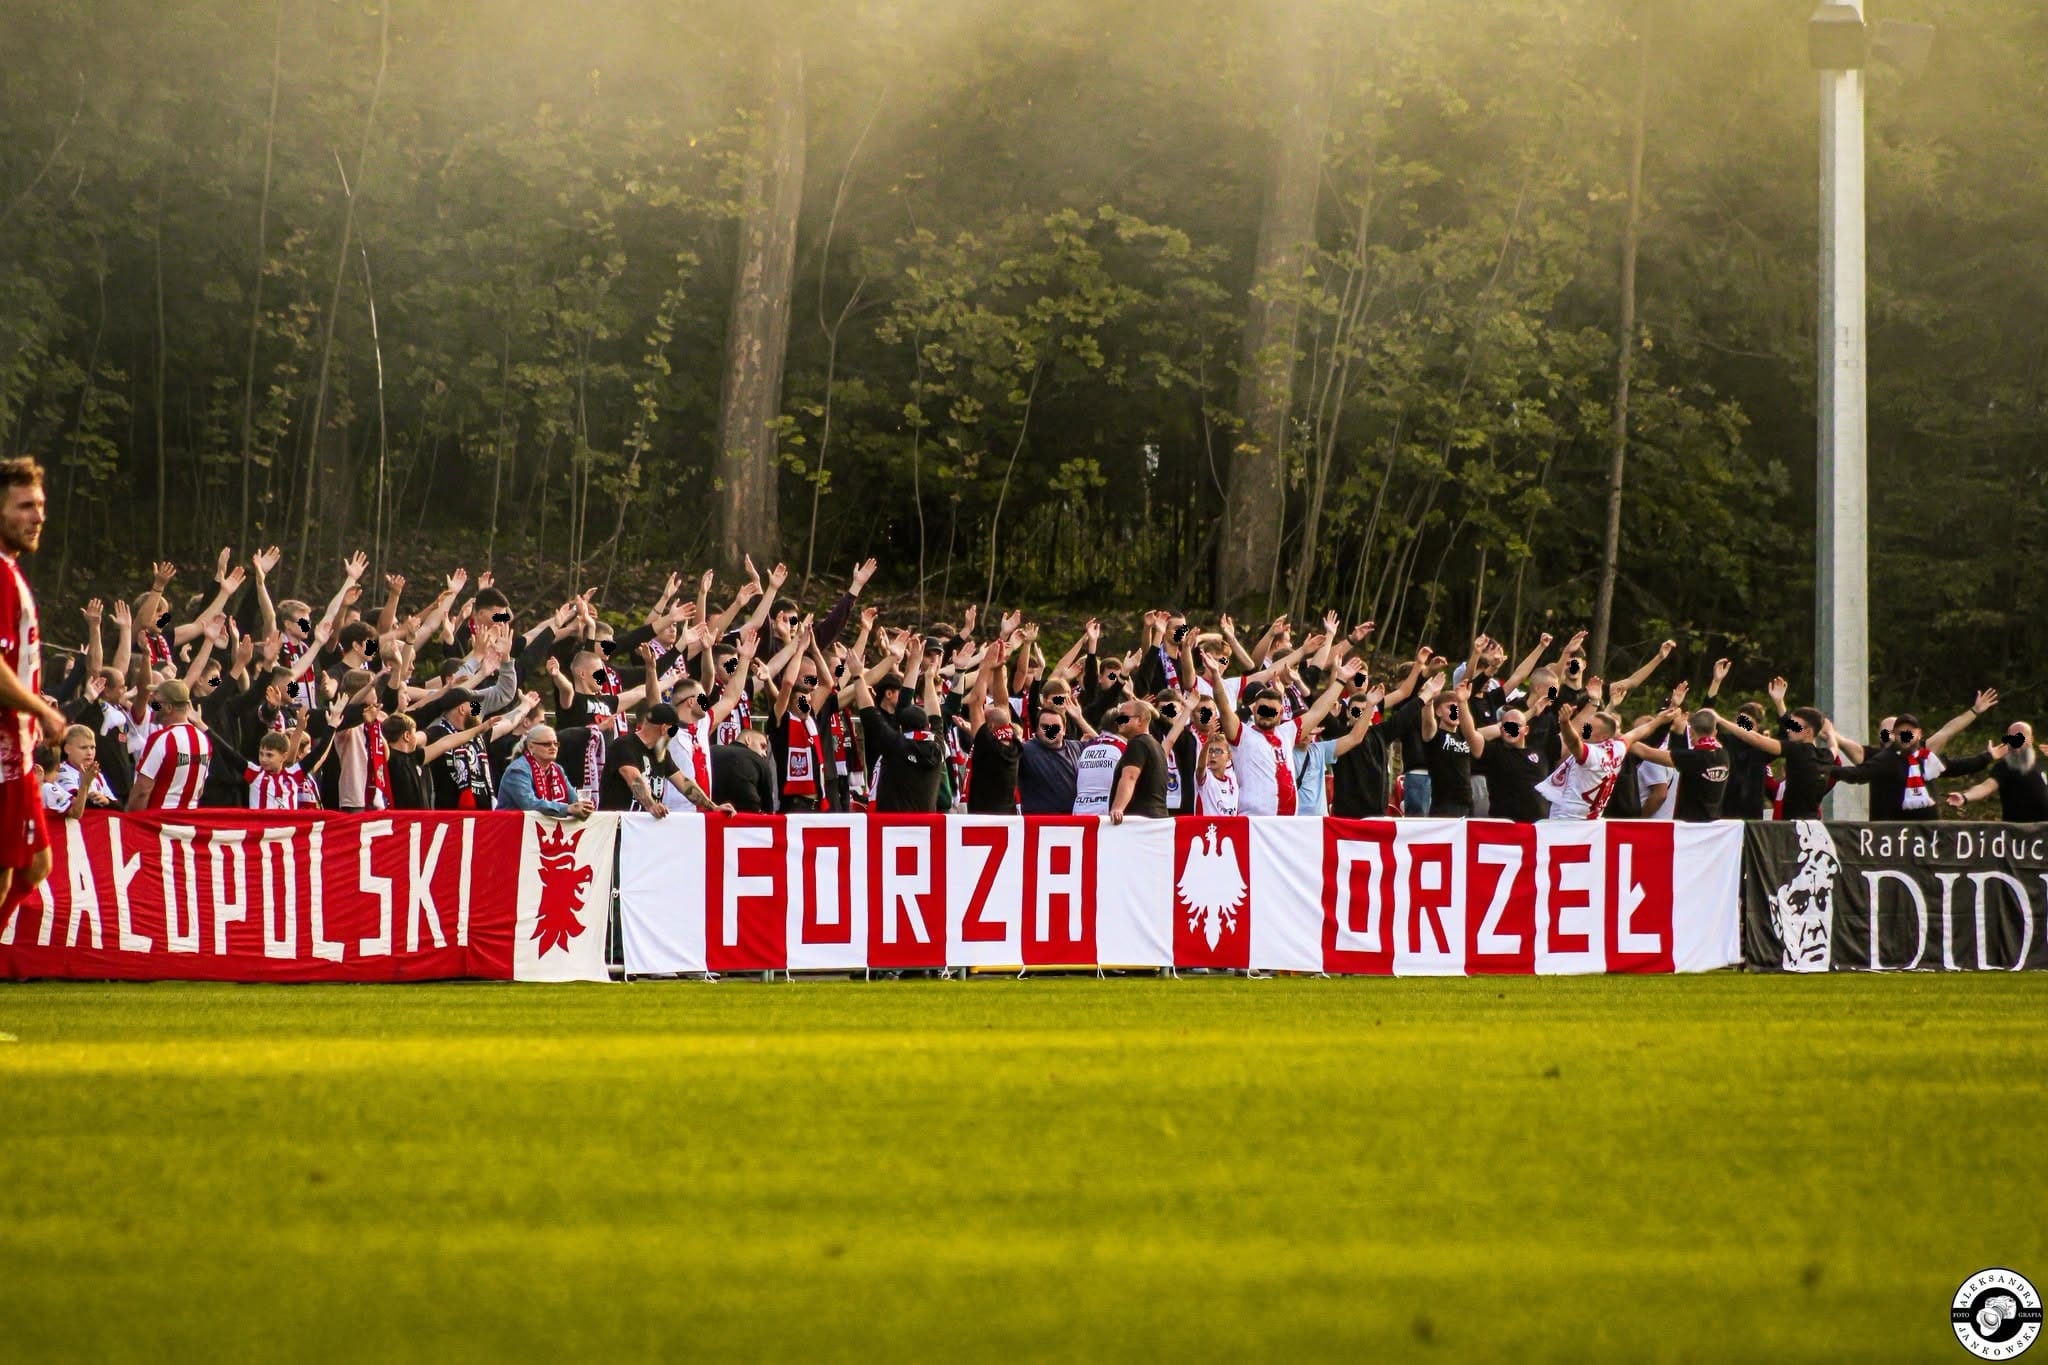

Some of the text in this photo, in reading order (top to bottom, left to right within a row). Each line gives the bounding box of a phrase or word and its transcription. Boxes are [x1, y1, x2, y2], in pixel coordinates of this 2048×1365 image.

[722, 825, 1085, 946] FORZA
[1336, 839, 1662, 954] ORZEŁ
[1861, 828, 2044, 861] Rafał Diduc
[1861, 871, 2048, 972] DID
